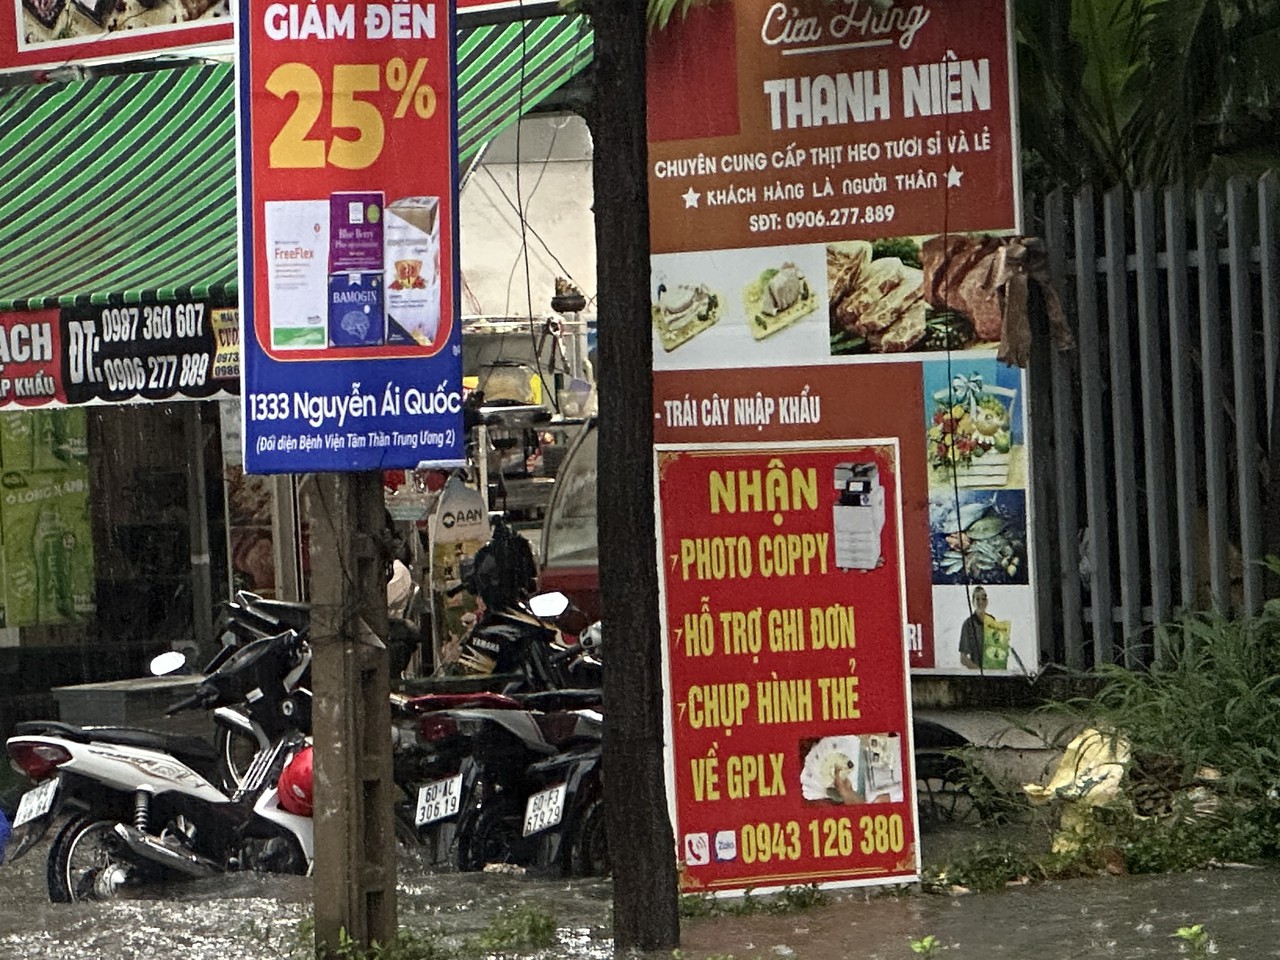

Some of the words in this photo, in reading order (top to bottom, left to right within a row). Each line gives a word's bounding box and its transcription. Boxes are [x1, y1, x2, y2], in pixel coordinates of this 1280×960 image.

[264, 57, 437, 170] 25%
[763, 69, 891, 131] THANH
[902, 50, 991, 119] NIÊN
[654, 153, 717, 178] CHUYÊN
[721, 152, 768, 173] CUNG
[771, 142, 806, 169] CẤP
[810, 146, 843, 170] THỊT
[848, 144, 881, 163] HEO
[884, 137, 923, 158] TƯƠI
[947, 130, 970, 154] VÀ
[974, 126, 992, 152] LẺ
[707, 183, 757, 206] KHÁCH
[813, 176, 835, 197] LÀ
[749, 212, 782, 233] SĐT:
[785, 204, 896, 230] 0906.277.889
[68, 319, 102, 384] ĐT:
[102, 307, 140, 343] 0987
[142, 304, 172, 339] 360
[175, 302, 206, 339] 607
[14, 370, 56, 396] KHẨU
[105, 356, 146, 392] 0906
[147, 354, 177, 388] 277
[178, 352, 210, 386] 889
[250, 393, 289, 421] 1333
[294, 382, 376, 427] Nguyễn
[381, 381, 400, 416] Ái
[404, 379, 462, 415] Quốc
[663, 393, 698, 427] TRÁI
[701, 392, 730, 427] CÂY
[733, 391, 775, 432] NHẬP
[778, 383, 821, 425] KHẨU
[299, 434, 321, 453] Bệnh
[325, 433, 345, 452] Viện
[347, 433, 366, 448] Tâm
[392, 431, 418, 449] Trung
[445, 429, 456, 448] 2)
[708, 458, 819, 527] NHẬN
[681, 535, 753, 581] PHOTO
[759, 533, 829, 578] COPPY
[472, 636, 500, 652] YAMAHA
[684, 596, 715, 657] HỖ
[720, 606, 763, 664] TRỢ
[768, 609, 805, 653] GHI
[810, 603, 856, 650] ĐƠN
[687, 682, 750, 736] CHỤP
[757, 671, 813, 724] HÌNH
[818, 658, 862, 722] THẺ
[690, 741, 720, 802] VỀ
[727, 753, 787, 800] GPLX
[740, 820, 802, 864] 0943
[808, 817, 853, 858] 126
[859, 813, 904, 855] 380
